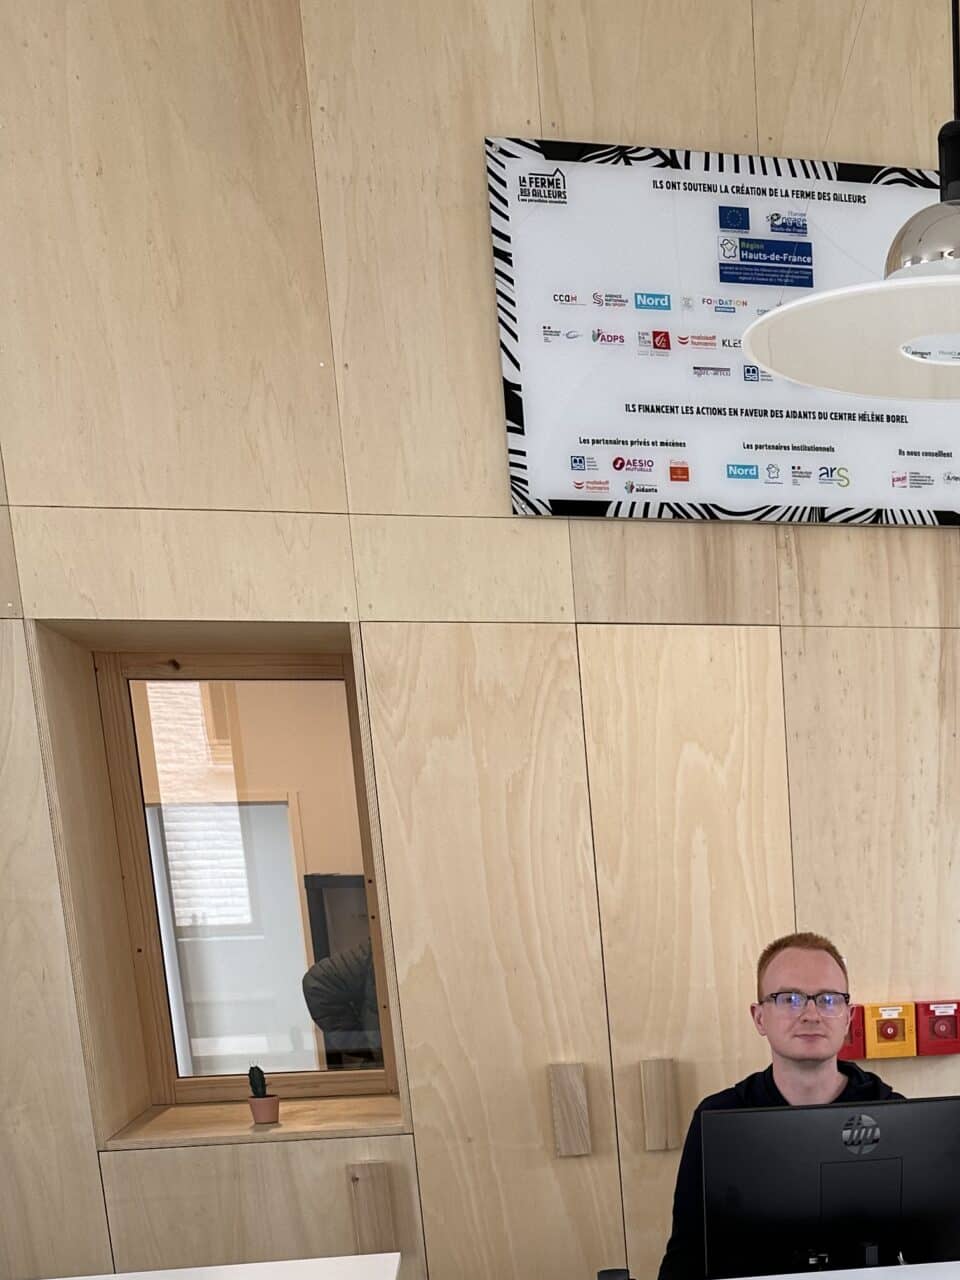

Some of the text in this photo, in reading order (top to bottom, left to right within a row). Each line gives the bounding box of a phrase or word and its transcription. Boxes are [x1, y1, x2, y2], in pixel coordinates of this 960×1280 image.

[529, 177, 561, 189] FERME
[652, 180, 664, 189] ILS
[665, 181, 681, 190] ONT
[683, 182, 718, 193] SOUTENU
[719, 185, 729, 193] LA
[769, 188, 778, 197] DE
[780, 189, 789, 198] LA
[791, 190, 815, 200] FERME
[817, 192, 831, 200] DES
[741, 250, 812, 263] Hauts-de-France
[637, 294, 668, 306] Nord
[600, 334, 625, 343] ADPS
[625, 404, 636, 413] ILS
[638, 404, 679, 414] FINANCENT
[681, 406, 694, 415] LES
[696, 406, 727, 416] ACTIONS
[728, 408, 738, 416] EN
[740, 408, 768, 418] FAVEUR
[770, 410, 784, 418] DES
[785, 410, 817, 420] AIDANTS
[818, 411, 828, 420] DU
[829, 412, 857, 421] CENTRE
[886, 414, 909, 424] BOREL
[579, 437, 590, 445] Les
[592, 437, 629, 446] partenaires
[630, 438, 650, 448] privés
[755, 442, 790, 451] partenaires
[729, 466, 757, 476] Nord
